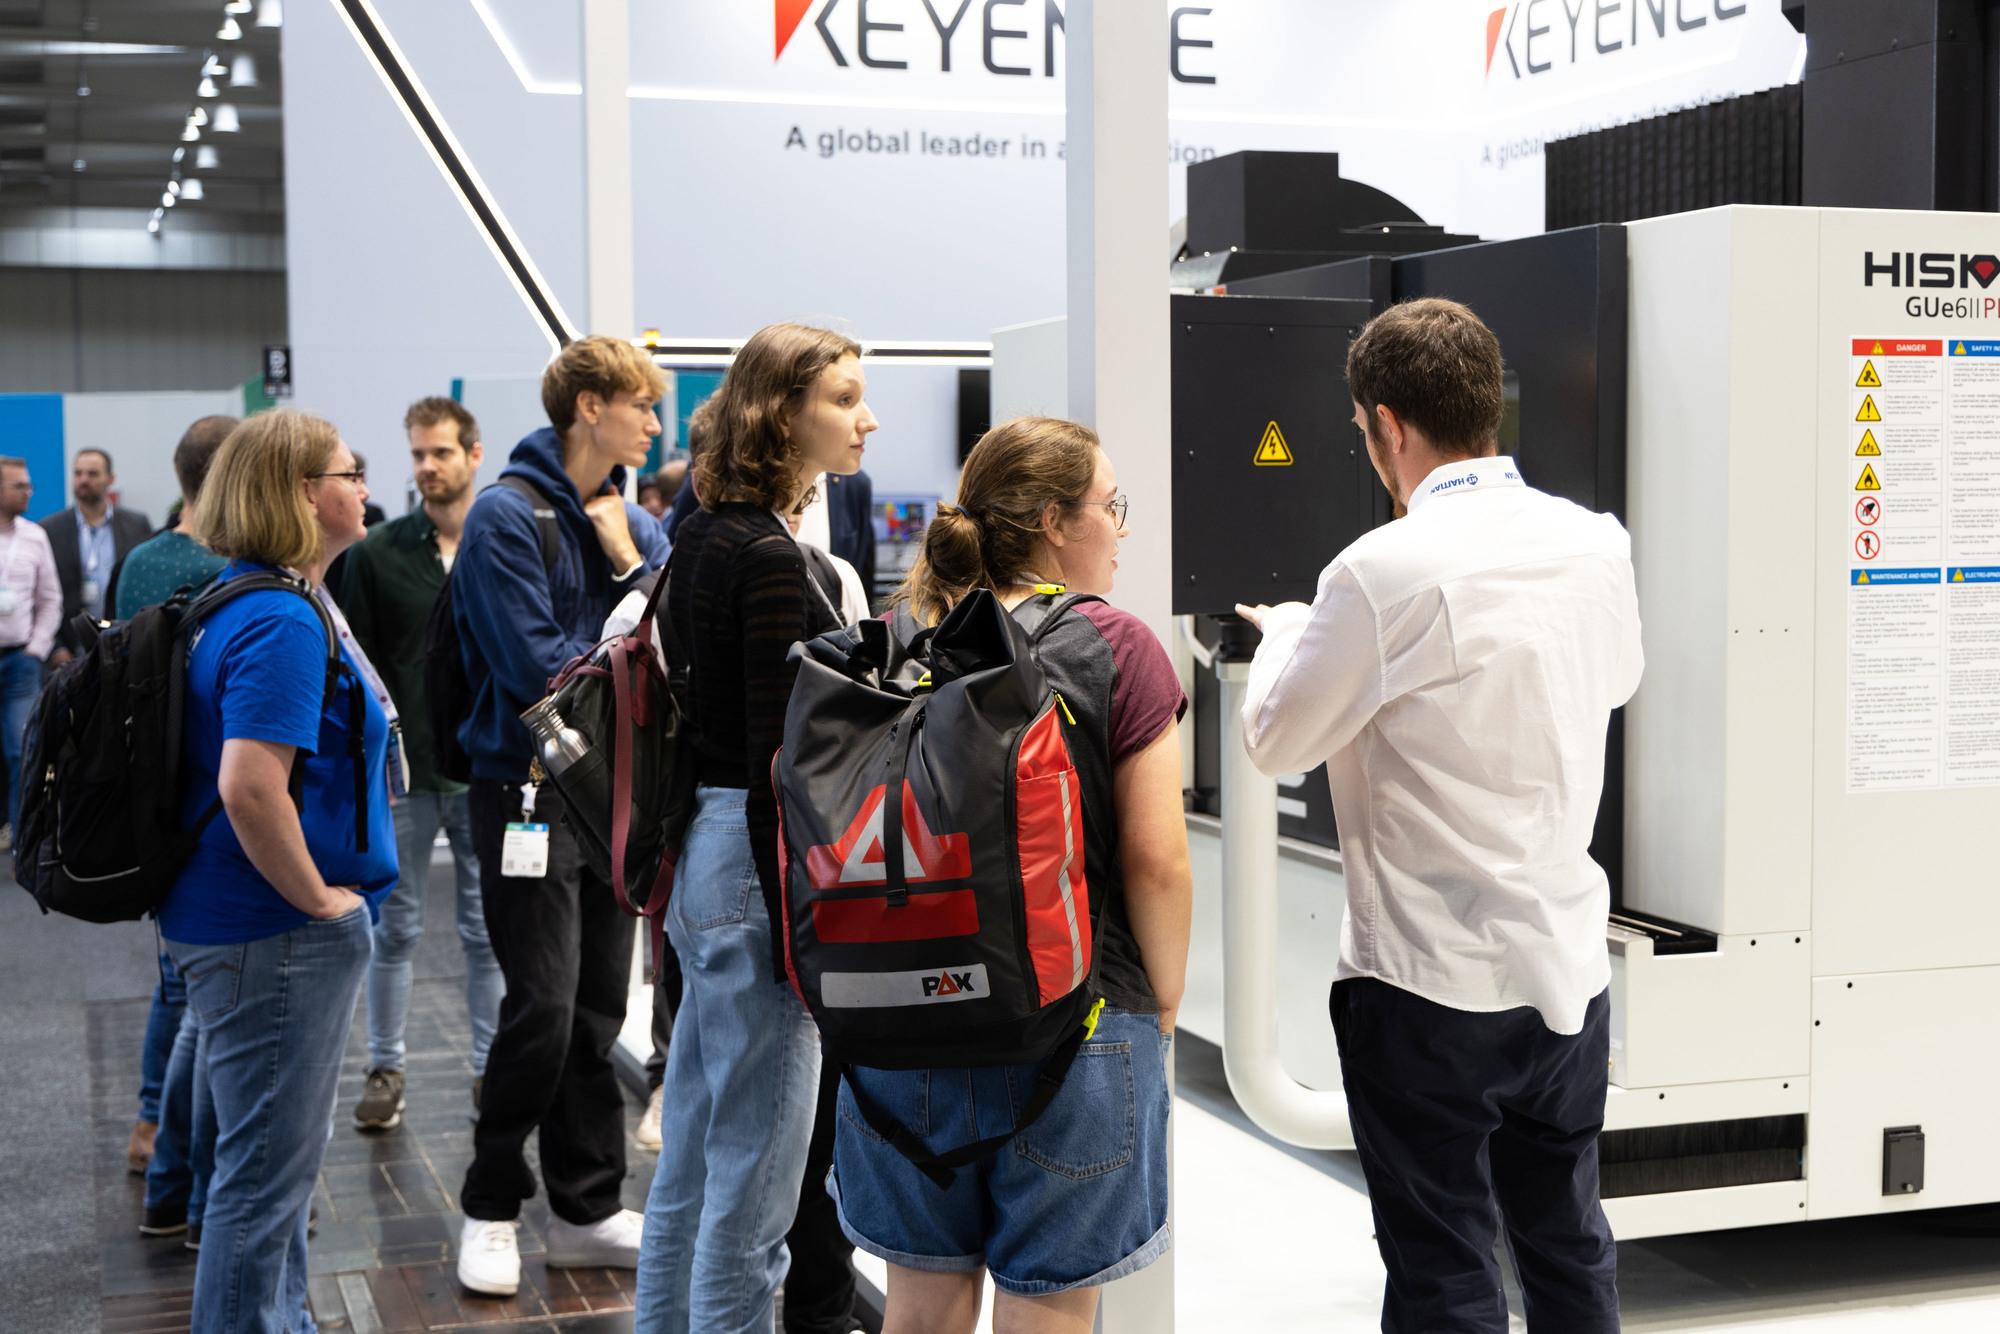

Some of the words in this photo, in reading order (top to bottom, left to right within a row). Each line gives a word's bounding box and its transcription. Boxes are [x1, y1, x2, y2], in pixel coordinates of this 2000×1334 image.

[775, 0, 1216, 84] KEYEE
[785, 126, 806, 149] A
[818, 128, 910, 158] global
[921, 131, 1011, 157] leader
[1022, 134, 1046, 157] in
[1896, 343, 1927, 352] DANGER
[921, 971, 975, 997] PAX
